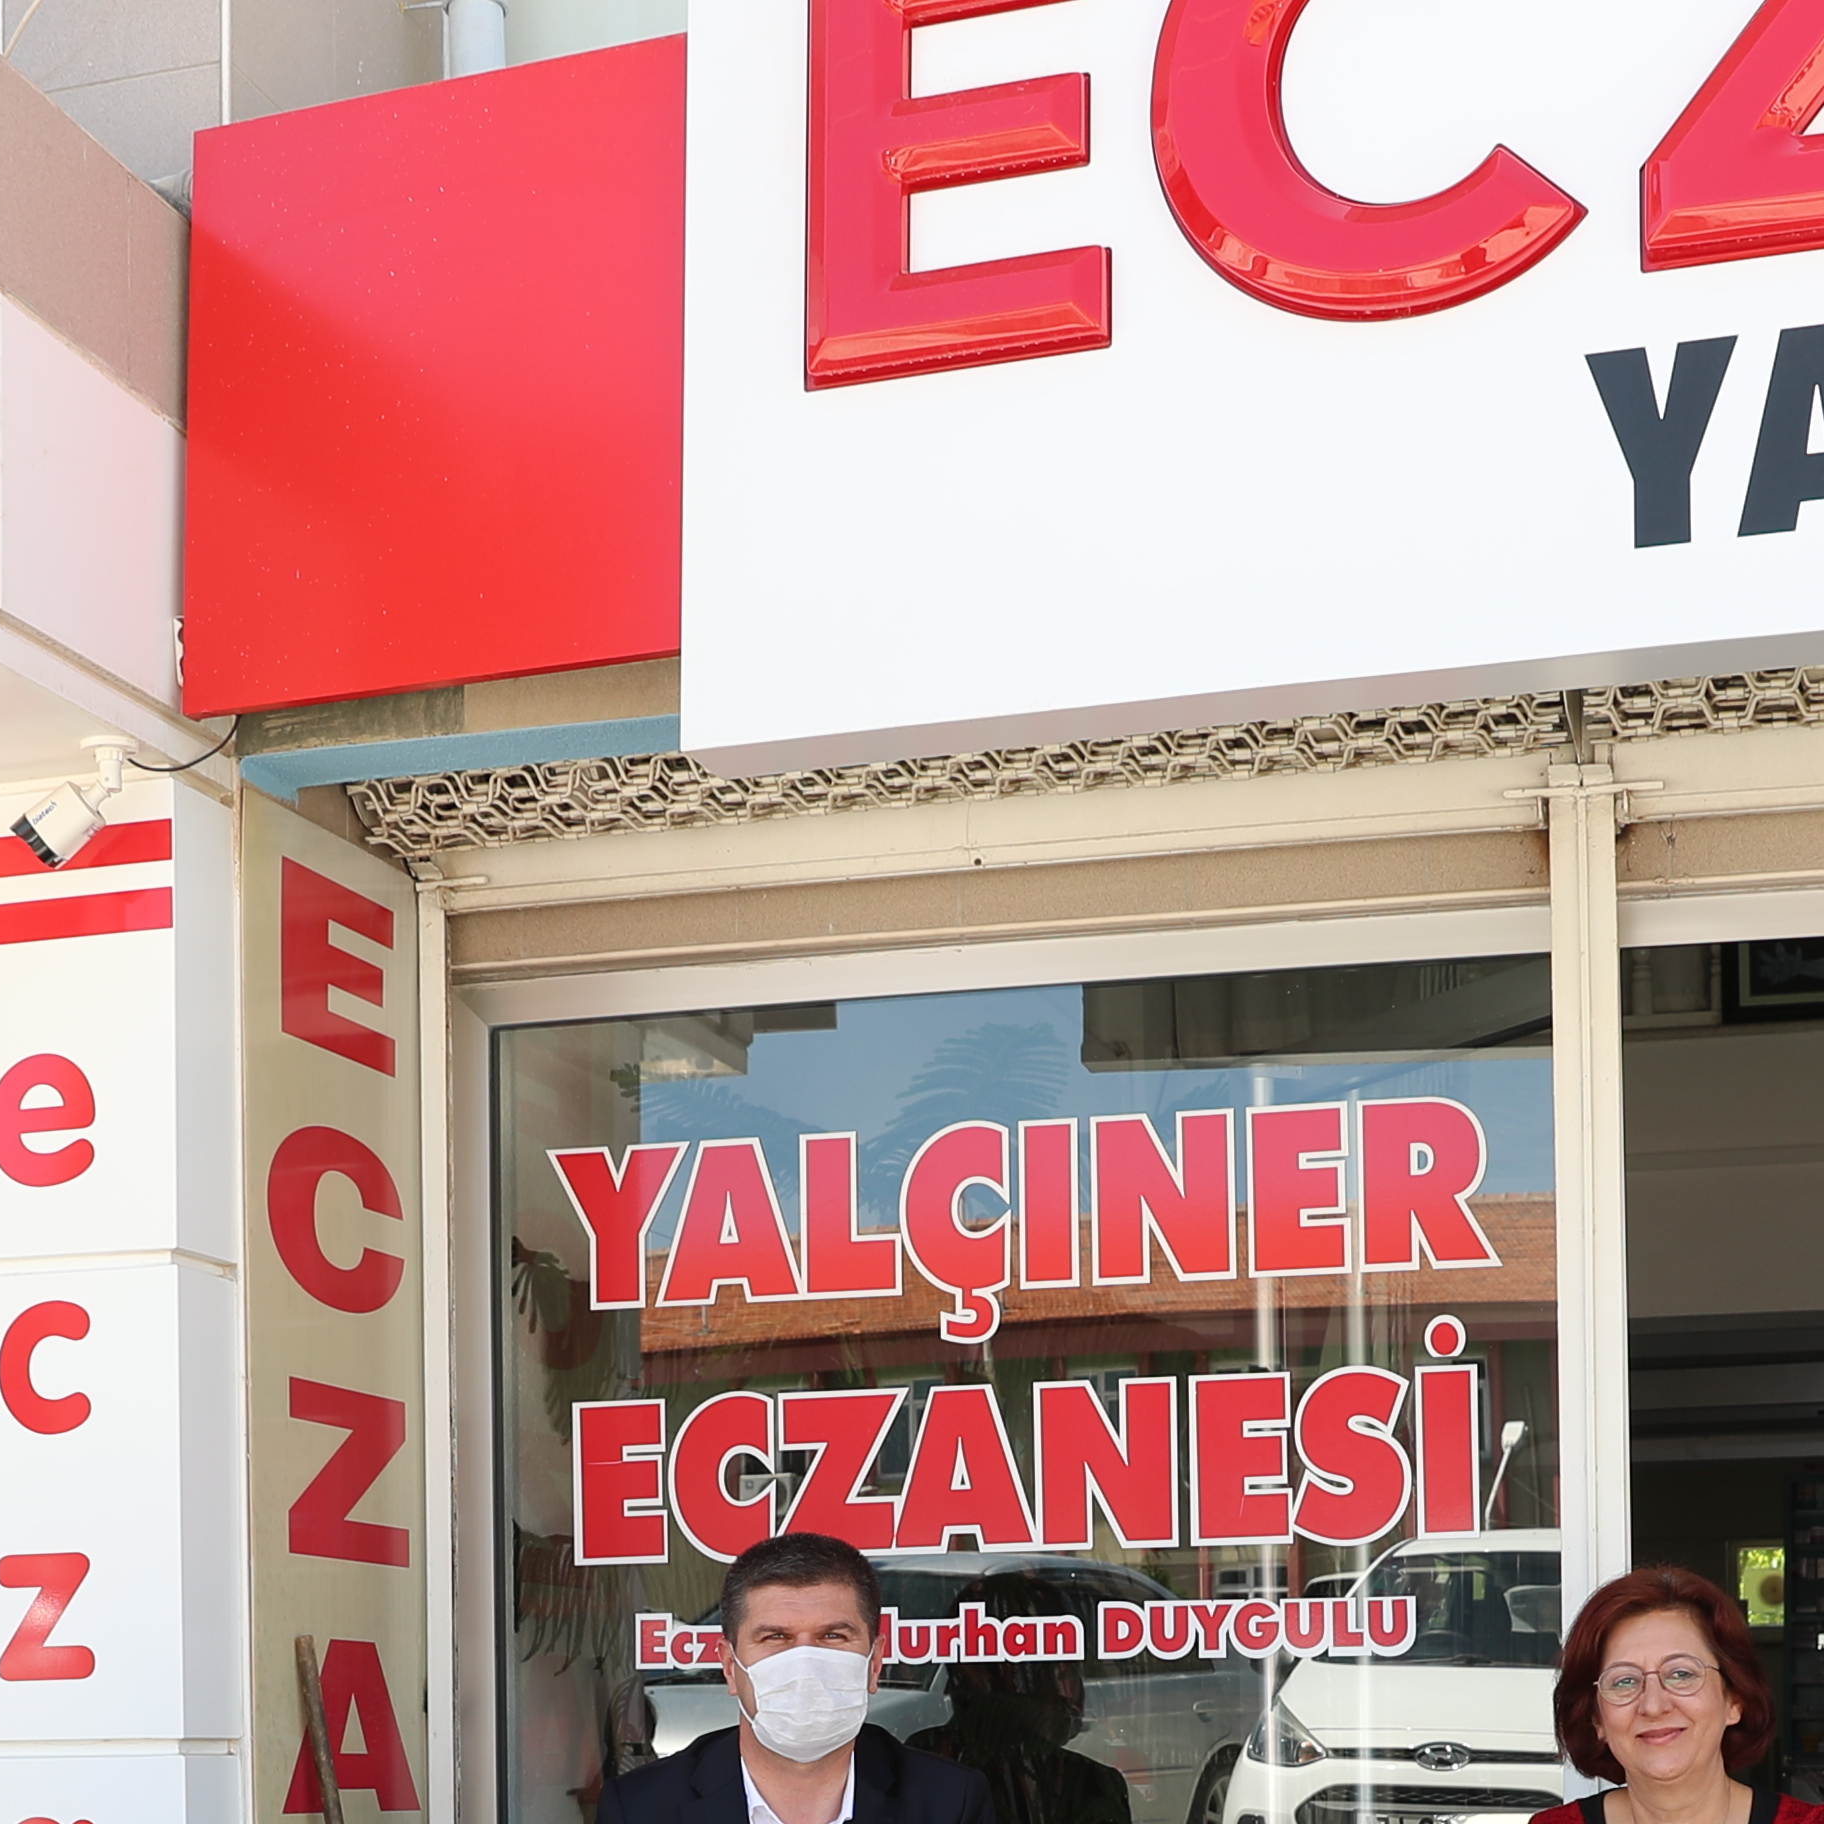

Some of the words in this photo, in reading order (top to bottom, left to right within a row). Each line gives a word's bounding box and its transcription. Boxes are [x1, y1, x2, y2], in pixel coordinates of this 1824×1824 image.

[545, 1095, 1502, 1344] YALÇINER
[571, 1314, 1480, 1566] ECZANESİ
[1097, 1595, 1416, 1659] DUYGULU
